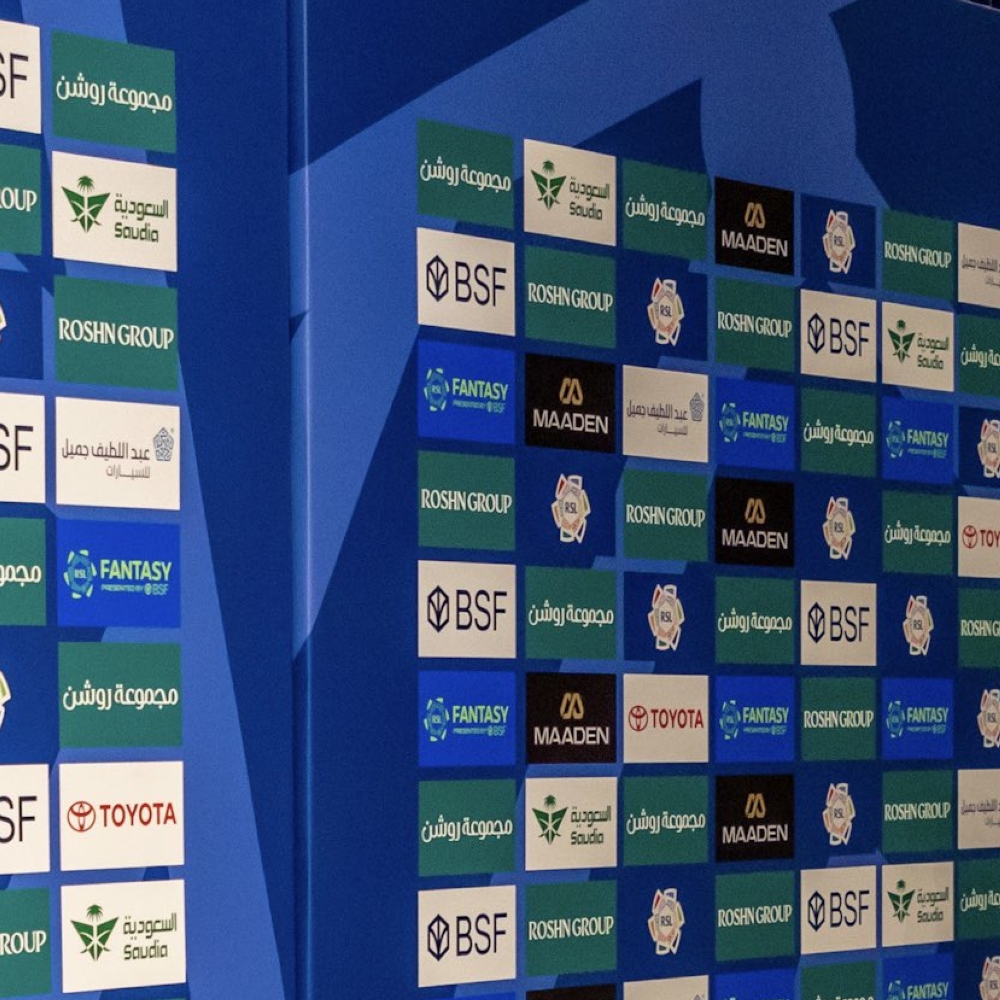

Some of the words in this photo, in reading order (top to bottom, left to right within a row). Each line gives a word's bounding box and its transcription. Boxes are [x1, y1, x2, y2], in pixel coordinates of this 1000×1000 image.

[56, 72, 106, 105] روشن
[107, 81, 171, 113] مجموعة
[420, 156, 459, 186] روشن
[460, 164, 511, 193] مجموعة
[0, 187, 38, 213] OUP
[570, 177, 609, 201] السعودية
[114, 194, 168, 221] السعودية
[570, 201, 602, 220] Saudia
[115, 222, 158, 242] Saudia
[722, 229, 787, 257] MAADEN
[885, 241, 917, 262] ROSHN
[918, 248, 951, 268] GROUP
[455, 261, 506, 306] BSF
[528, 282, 570, 306] ROSHN
[571, 289, 613, 312] GROUP
[660, 305, 671, 317] RSL
[59, 318, 115, 344] ROSHN
[117, 324, 174, 349] GROUP
[830, 318, 869, 357] BSF
[452, 377, 508, 400] FANTASY
[533, 408, 608, 434] MAADEN
[674, 409, 687, 420] عبد
[742, 411, 788, 431] FANTASY
[62, 439, 89, 458] جميل
[907, 429, 948, 447] FANTASY
[91, 442, 128, 460] اللطيف
[131, 448, 149, 460] عبد
[421, 488, 465, 510] ROSHN
[467, 492, 512, 513] GROUP
[565, 502, 577, 513] RSL
[884, 520, 913, 544] روشن
[913, 525, 951, 546] مجموعة
[100, 559, 171, 581] FANTASY
[152, 582, 167, 595] BSF
[456, 590, 507, 631] BSF
[528, 600, 565, 626] روشن
[566, 604, 613, 627] مجموعة
[661, 611, 672, 622] RSL
[830, 606, 869, 642] BSF
[961, 619, 991, 636] ROSHN
[63, 680, 112, 710] روشن
[114, 684, 178, 710] مجموعة
[452, 705, 508, 723] FANTASY
[650, 709, 703, 728] TOYOTA
[742, 707, 788, 723] FANTASY
[803, 710, 838, 727] ROSHN
[839, 710, 874, 727] GROUP
[534, 726, 609, 745] MAADEN
[0, 795, 38, 844] SF
[99, 803, 176, 827] TOYOTA
[571, 806, 610, 827] السعودية
[421, 814, 461, 842] روشن
[462, 817, 513, 840] مجموعة
[571, 828, 603, 845] Saudia
[722, 824, 788, 843] MAADEN
[830, 890, 869, 927] BSF
[123, 913, 177, 939] السعودية
[529, 919, 570, 940] ROSHN
[572, 915, 614, 936] GROUP
[661, 915, 672, 926] RSL
[0, 929, 47, 956] ROUP
[456, 912, 507, 956] BSF
[124, 940, 167, 960] Saudia
[907, 982, 948, 1000] FANTASY
